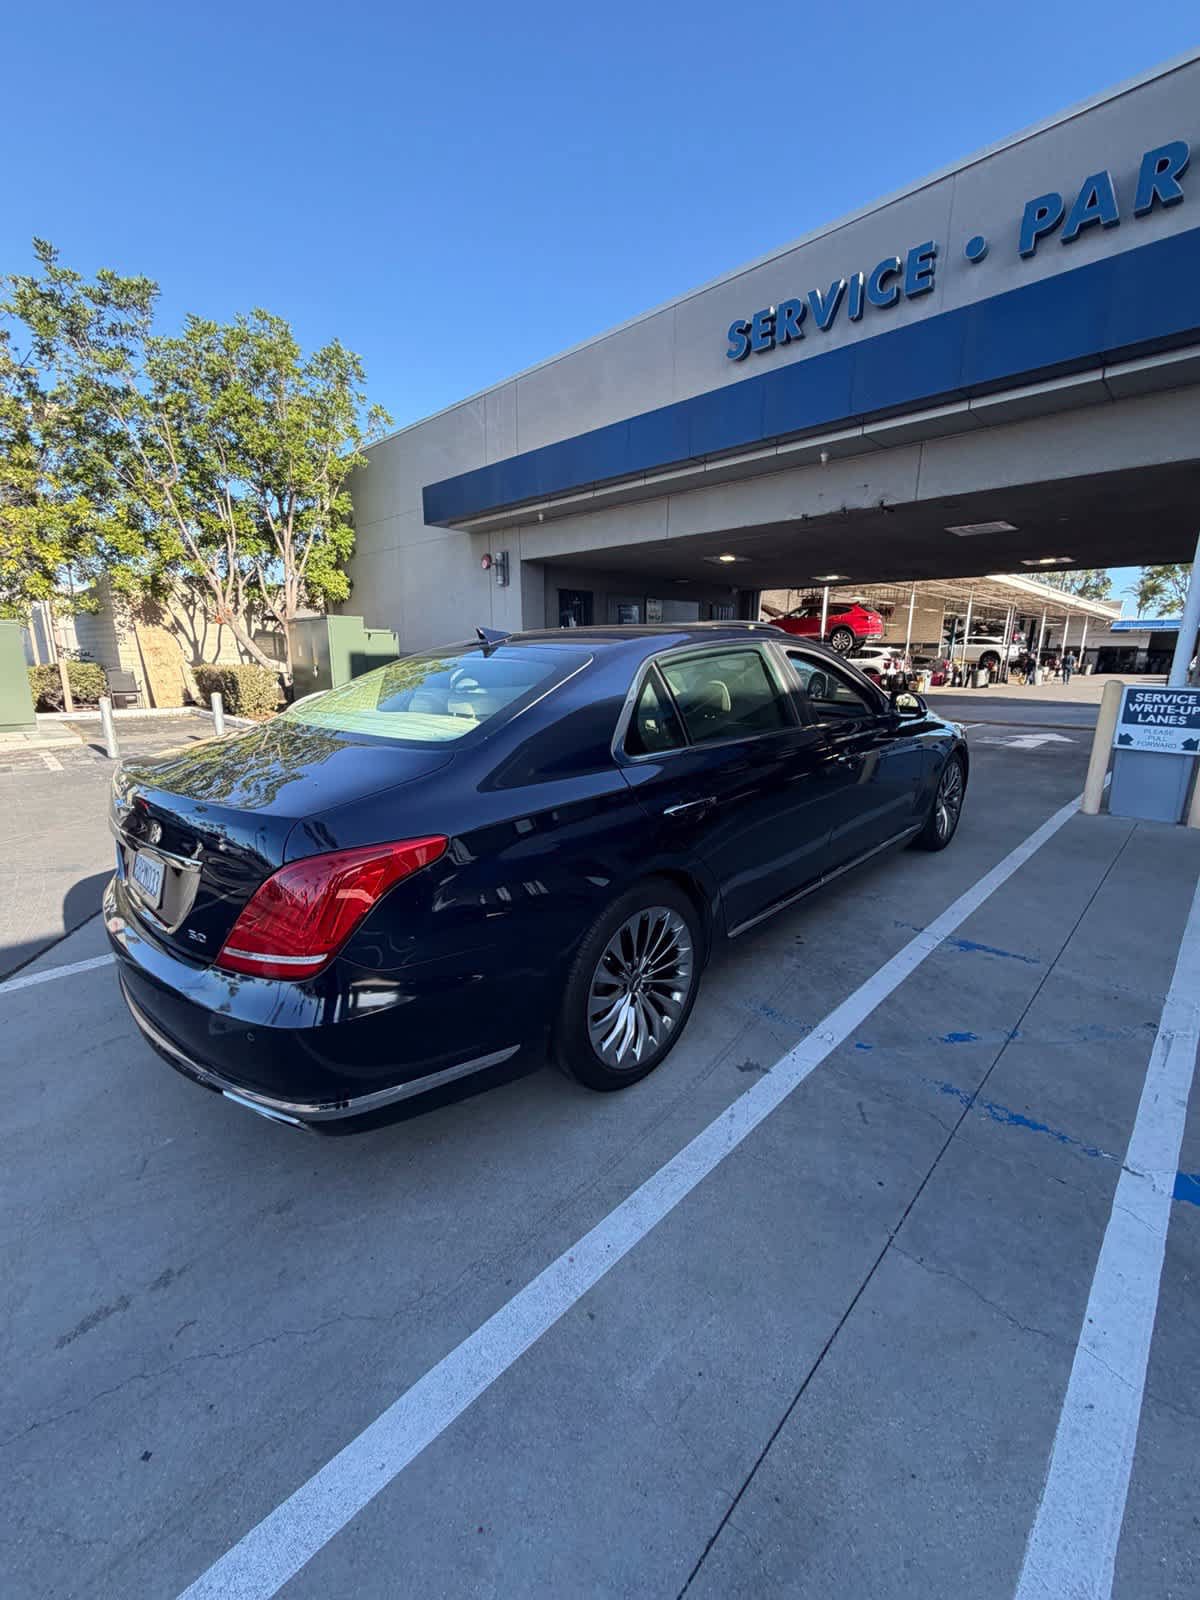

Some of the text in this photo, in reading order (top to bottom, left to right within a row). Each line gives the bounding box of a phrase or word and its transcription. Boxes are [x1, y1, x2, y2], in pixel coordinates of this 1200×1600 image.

[726, 240, 937, 361] SERVICE
[1135, 692, 1197, 705] SERVICE
[1128, 703, 1200, 715] WRITE-UP
[1137, 713, 1188, 725] LANES
[1143, 728, 1175, 736] PLEASE
[1136, 740, 1177, 749] FORWARD
